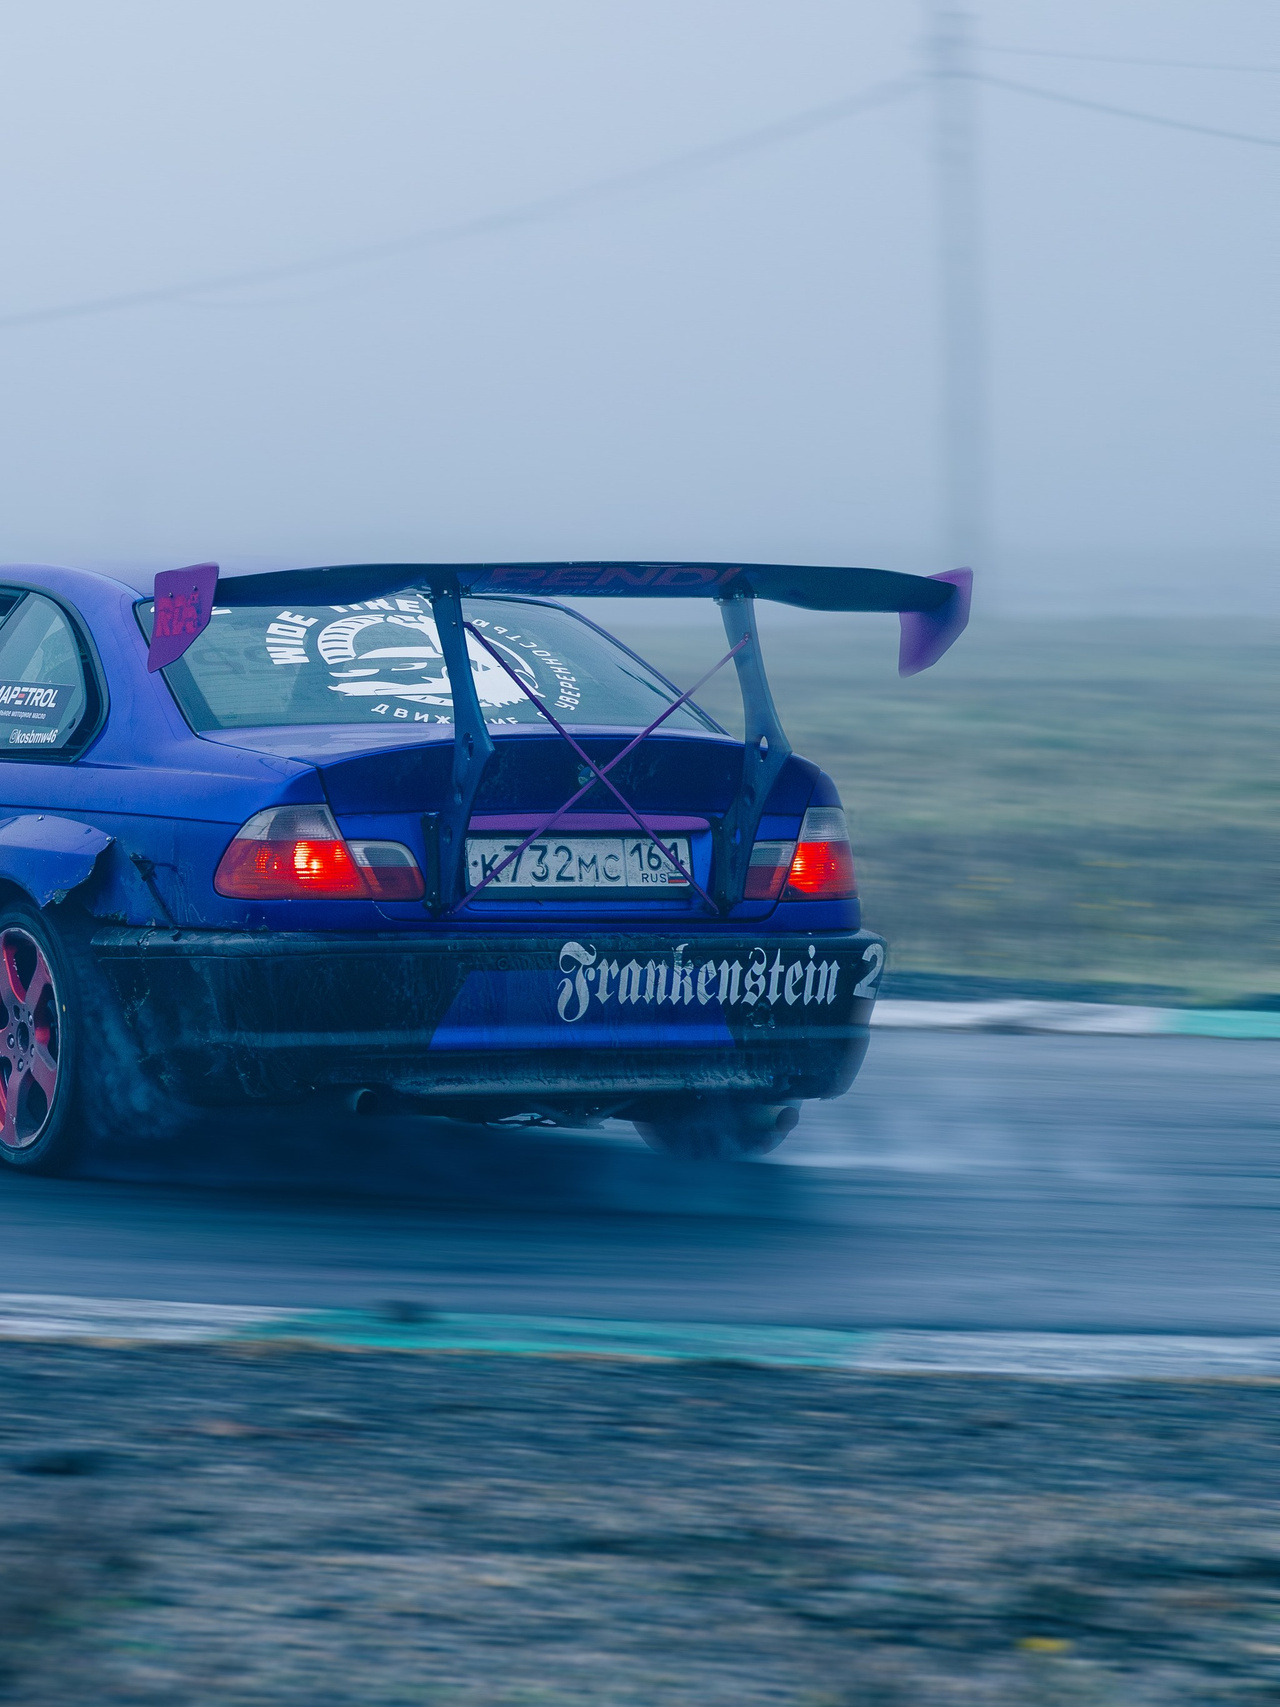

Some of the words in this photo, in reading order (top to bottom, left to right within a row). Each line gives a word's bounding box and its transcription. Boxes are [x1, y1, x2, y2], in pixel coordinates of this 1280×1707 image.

[490, 567, 743, 586] RENDI
[266, 611, 319, 665] WIDE
[371, 703, 518, 725] ДВИЖИЕ
[472, 619, 581, 711] УВЕРЕННОСТЬЮ
[642, 873, 667, 883] RUS
[557, 941, 841, 1023] Frankenstein
[853, 943, 884, 999] 2
